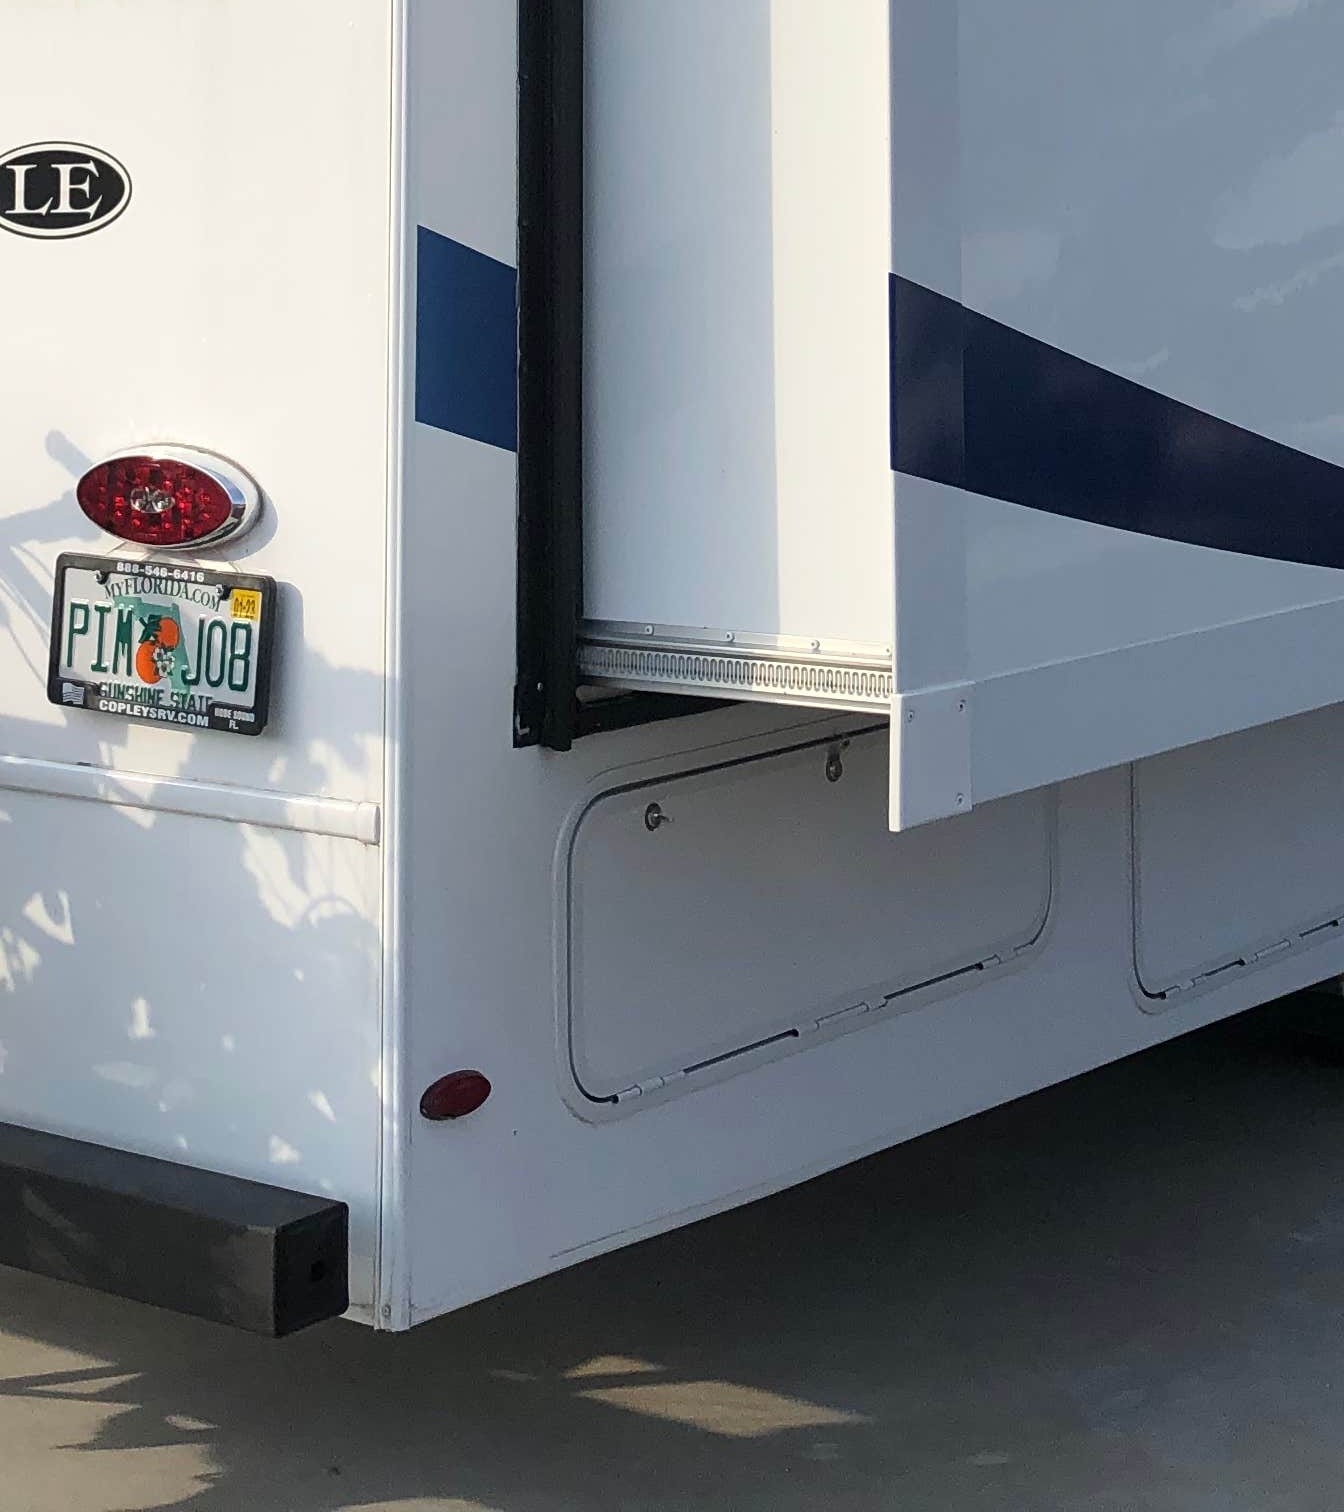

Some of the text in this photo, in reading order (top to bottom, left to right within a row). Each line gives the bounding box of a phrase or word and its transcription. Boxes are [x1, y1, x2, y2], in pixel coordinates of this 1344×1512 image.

[4, 157, 104, 218] LE
[105, 576, 220, 612] MYFLORIDA.COM
[66, 598, 252, 693] PIM JOB
[99, 681, 213, 712] SUNSHINE STATE
[99, 699, 209, 727] COPLEYSRV.COM
